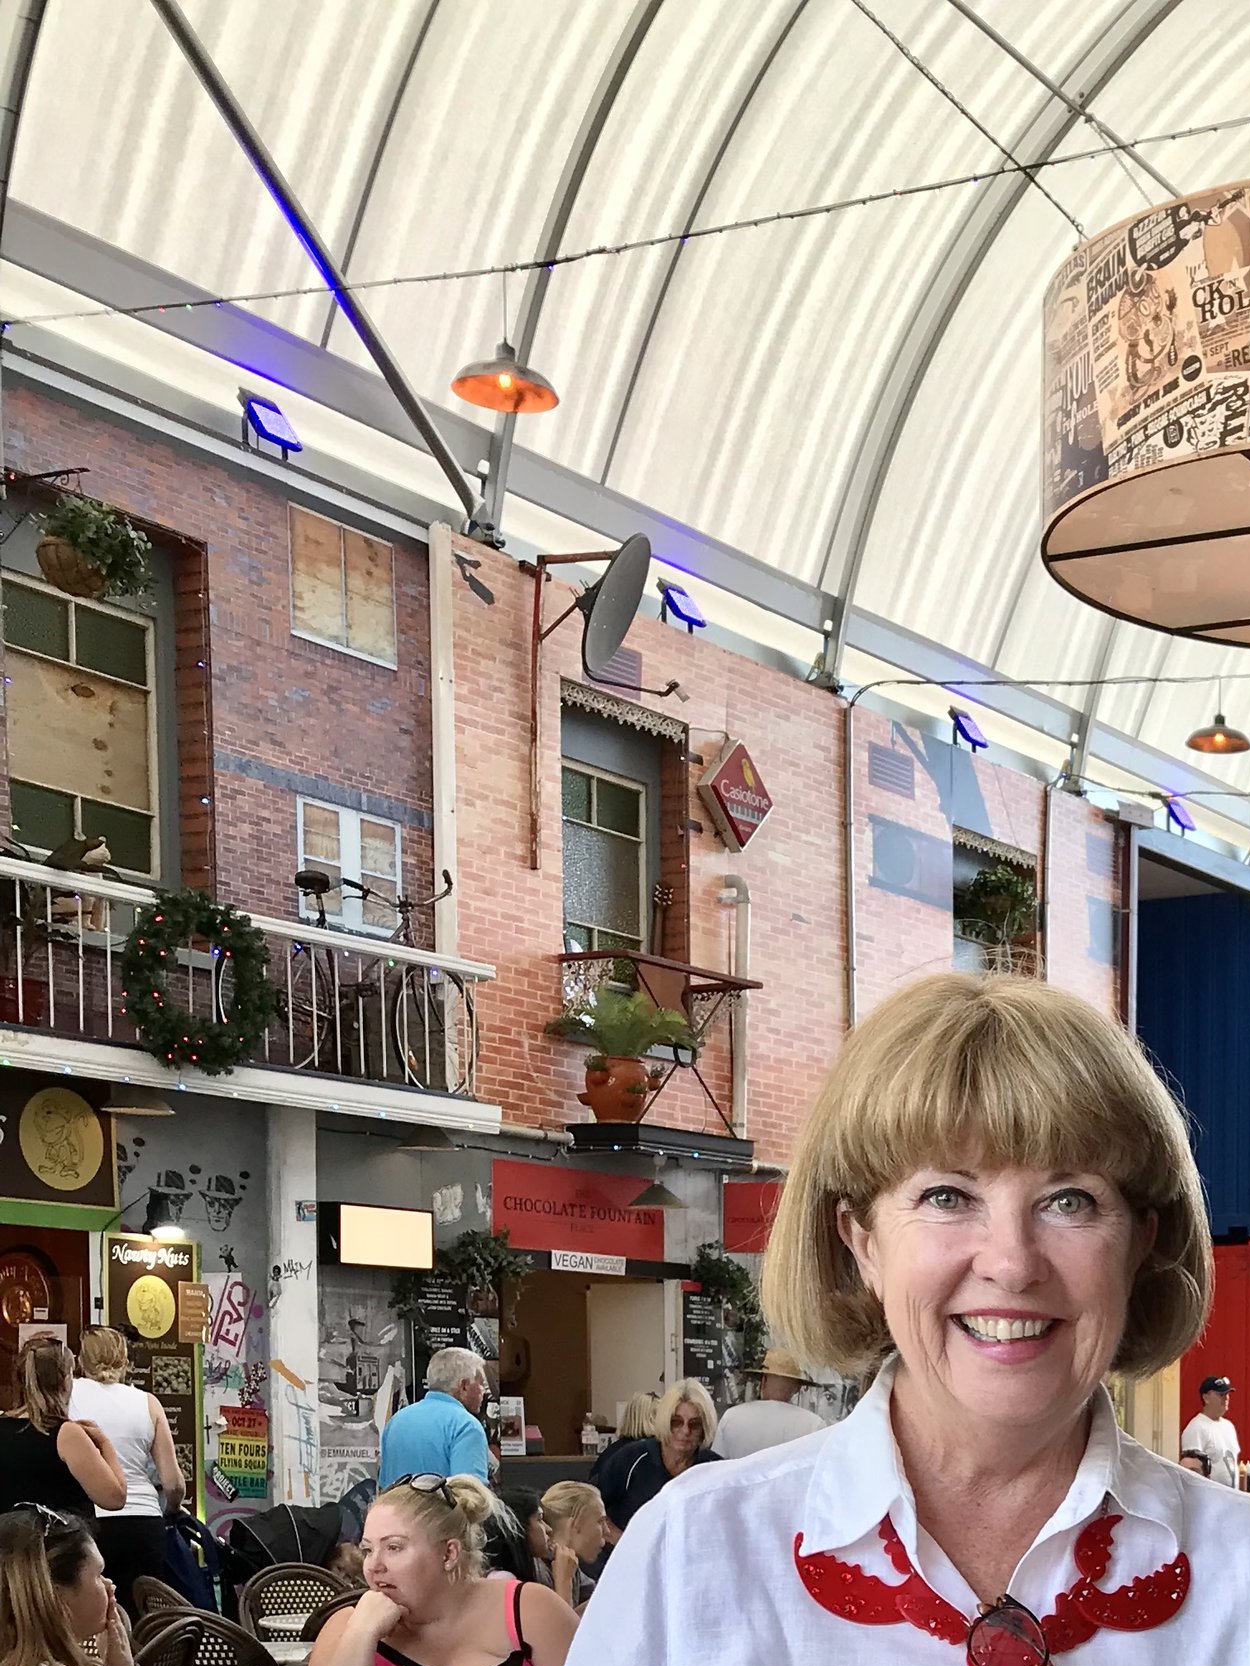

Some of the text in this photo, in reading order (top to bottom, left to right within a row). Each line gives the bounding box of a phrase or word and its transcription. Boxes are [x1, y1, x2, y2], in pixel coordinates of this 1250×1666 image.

[1209, 342, 1229, 358] SEPT
[720, 779, 769, 811] Casiotone
[503, 1195, 656, 1226] CHOCOLATE FOUNTAIN
[157, 1247, 190, 1268] Nuts
[554, 1253, 593, 1270] VEGAN
[232, 1416, 257, 1427] OCT 27
[220, 1442, 267, 1458] TEN FOURS
[220, 1457, 266, 1471] FLYING SQUAD
[212, 1466, 236, 1496] PROJECT
[249, 1476, 265, 1488] BAR
